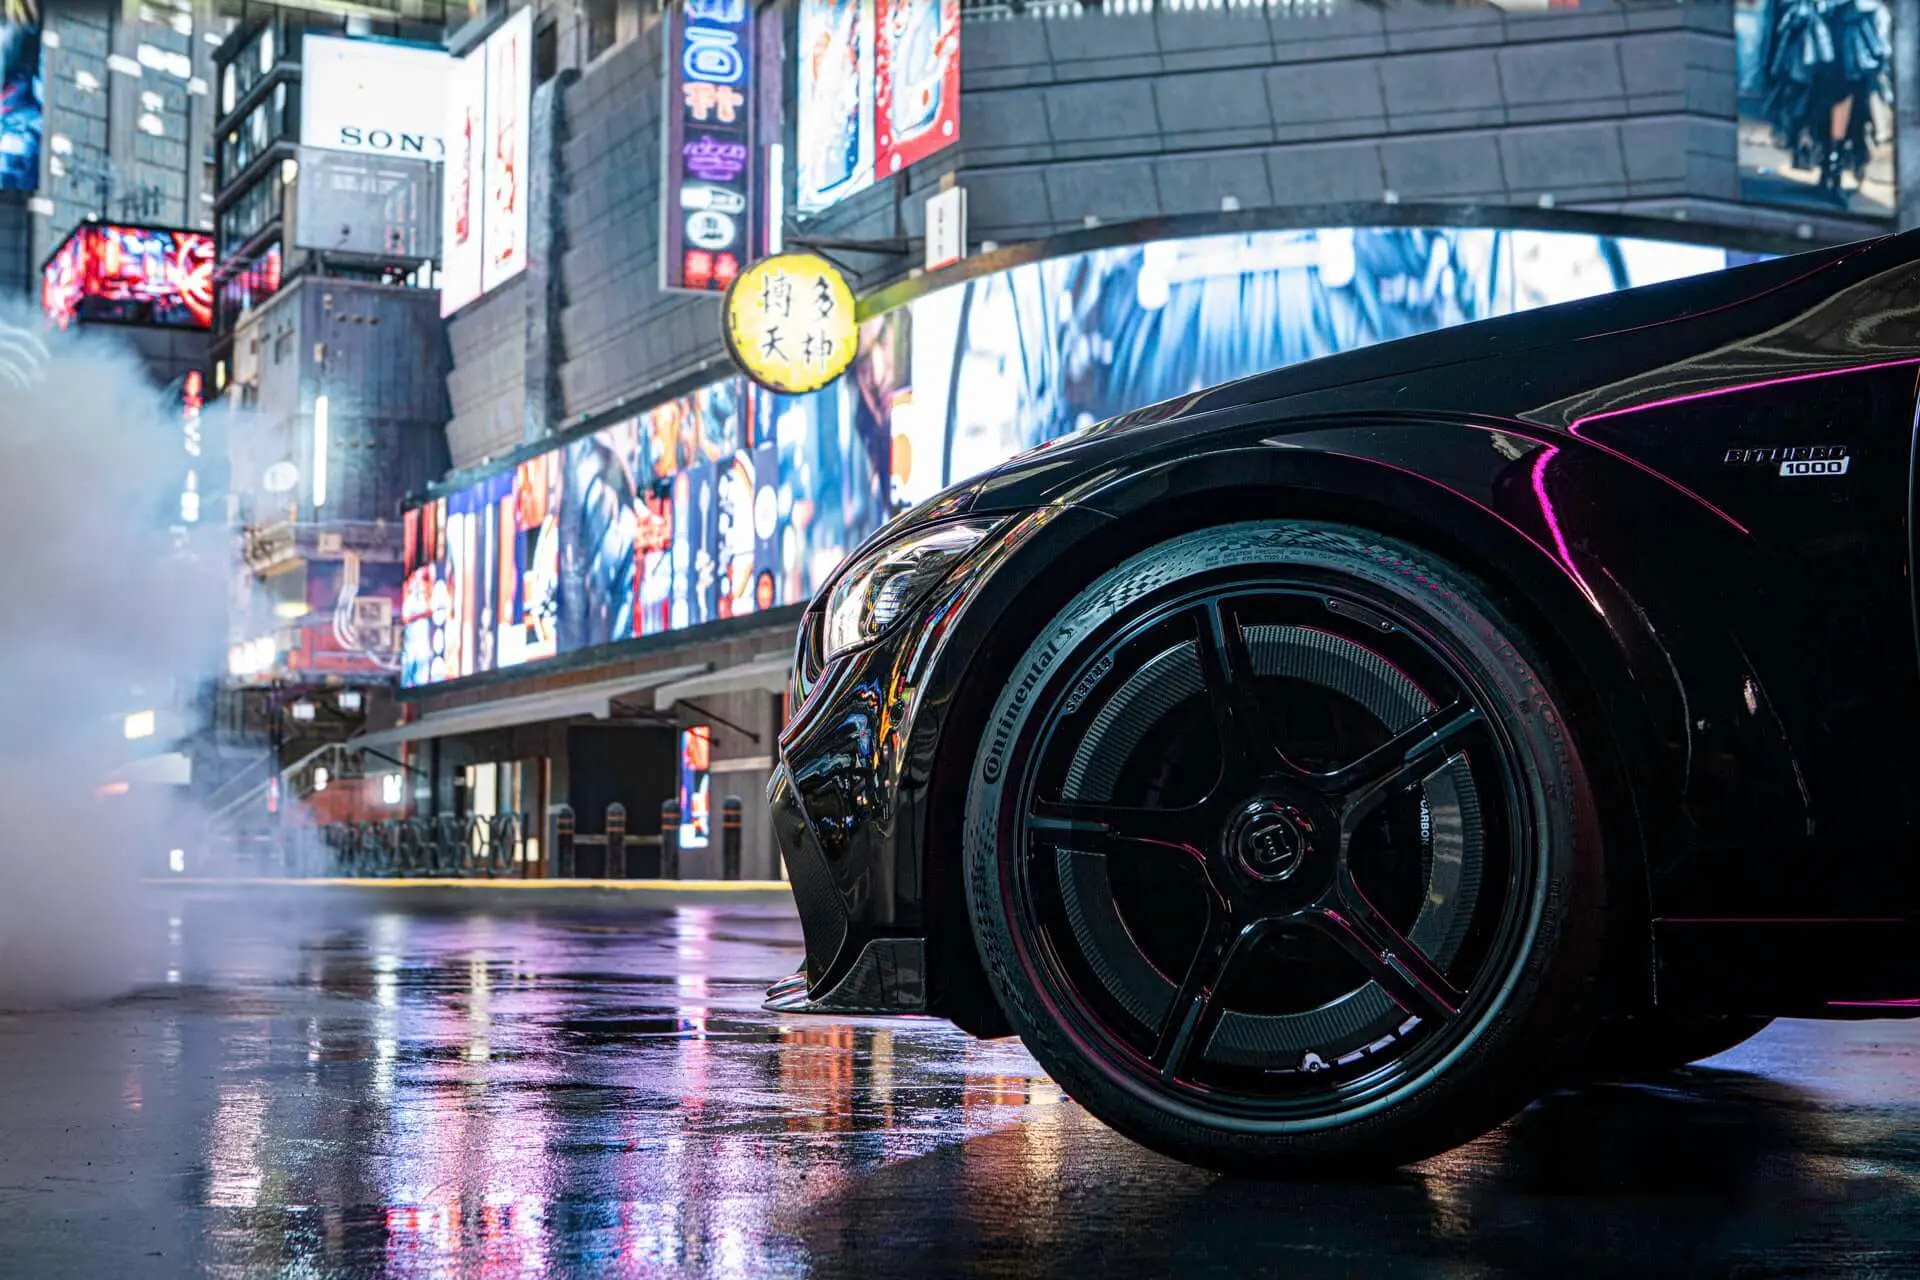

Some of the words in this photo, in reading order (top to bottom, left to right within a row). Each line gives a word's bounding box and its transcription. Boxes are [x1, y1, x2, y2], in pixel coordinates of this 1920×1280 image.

[1724, 446, 1847, 464] BITURBO
[1786, 461, 1842, 474] 1000
[1065, 656, 1113, 712] BRABUS
[983, 641, 1060, 785] Continental
[1420, 799, 1431, 848] CARBON
